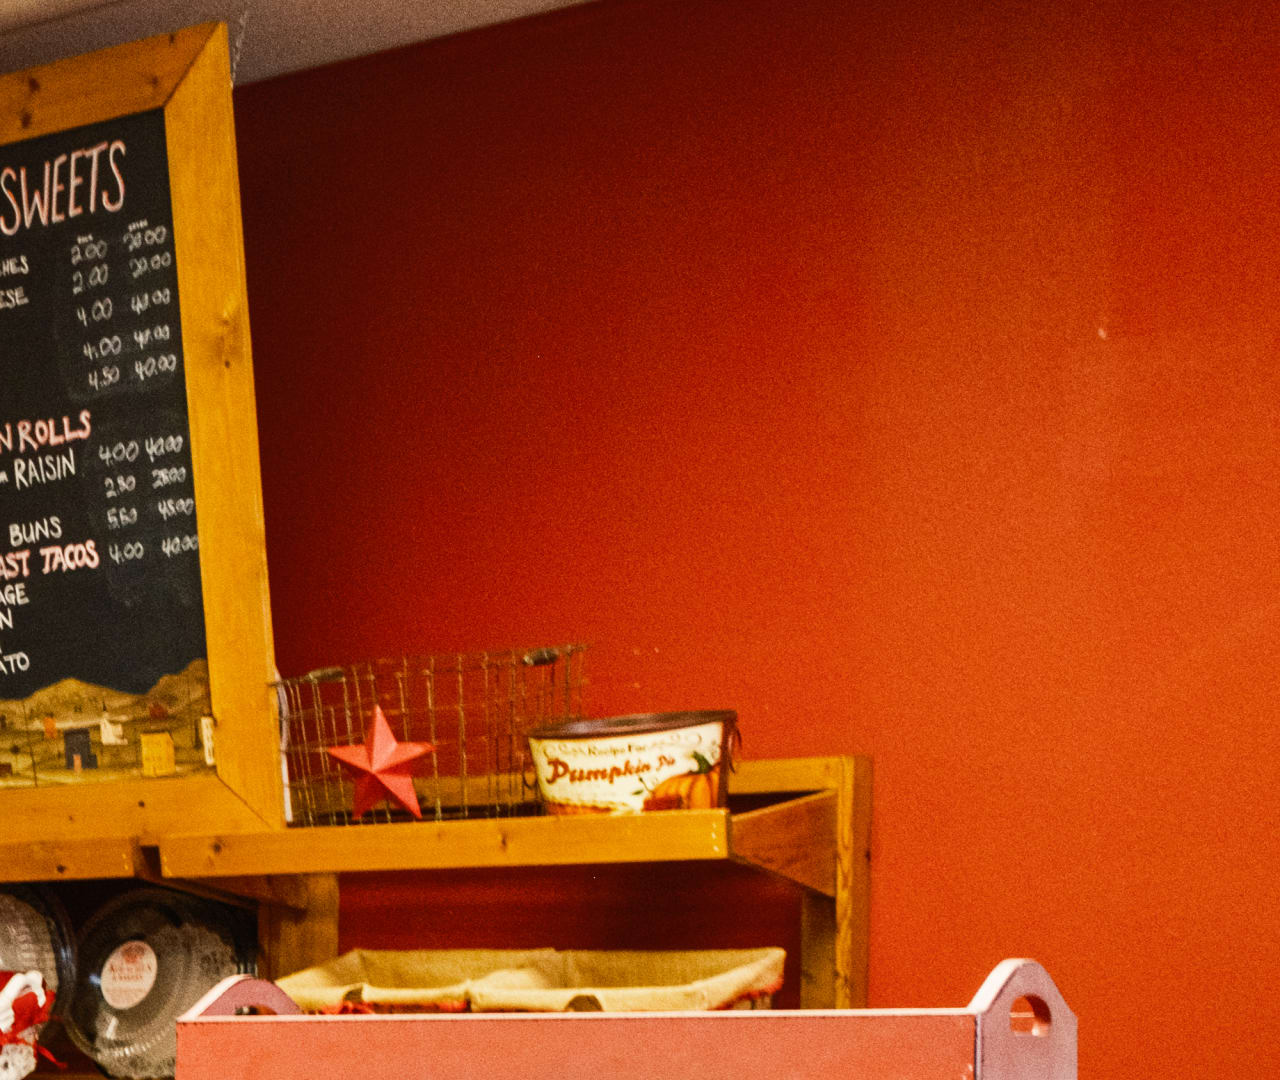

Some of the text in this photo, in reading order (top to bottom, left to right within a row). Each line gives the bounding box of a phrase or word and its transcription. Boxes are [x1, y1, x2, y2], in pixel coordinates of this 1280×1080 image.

[0, 140, 126, 236] SWEETS
[17, 408, 92, 453] ROLLS
[13, 446, 77, 490] RAISIN
[8, 516, 62, 547] BUNS
[39, 539, 100, 574] TACOS
[546, 757, 652, 785] Pumpkin
